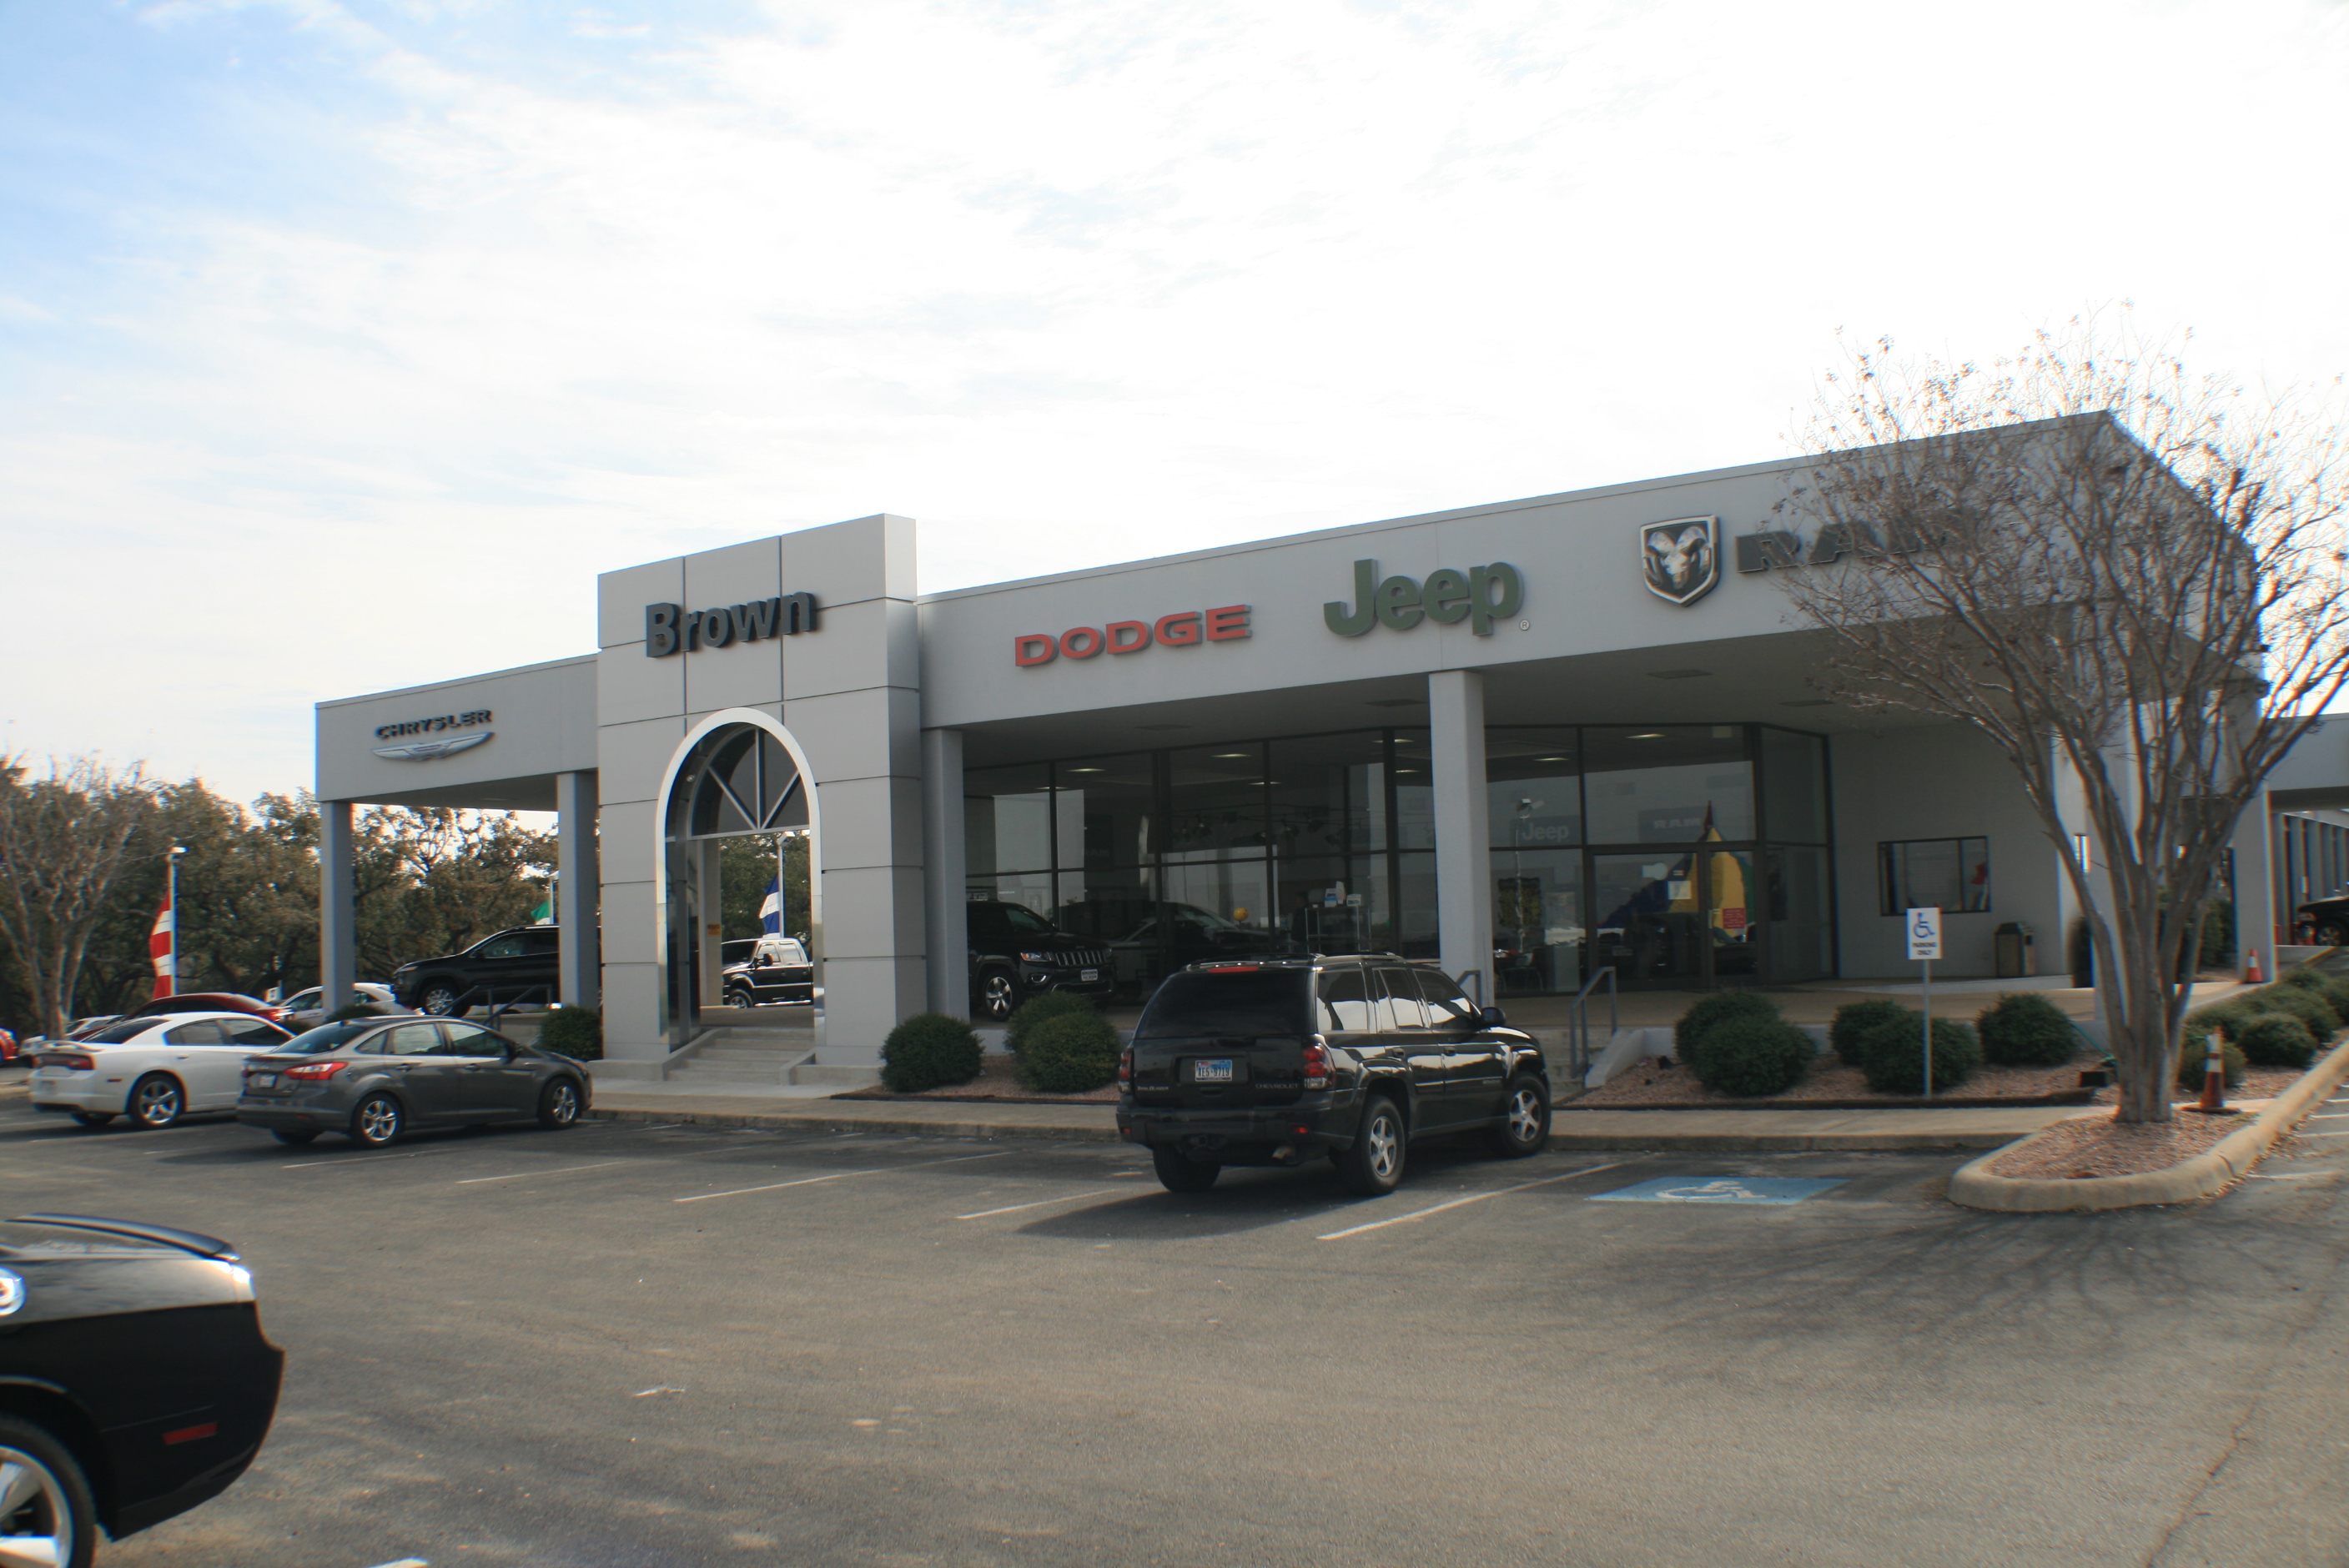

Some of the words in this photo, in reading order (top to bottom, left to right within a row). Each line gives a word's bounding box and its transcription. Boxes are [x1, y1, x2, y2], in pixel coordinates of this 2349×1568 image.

[1324, 559, 1525, 636] Jeep
[646, 591, 817, 657] Brown
[1015, 605, 1251, 667] DODGE
[376, 710, 493, 739] CHRYSLER
[1521, 822, 1569, 842] Jeep
[1654, 817, 1701, 829] RAM
